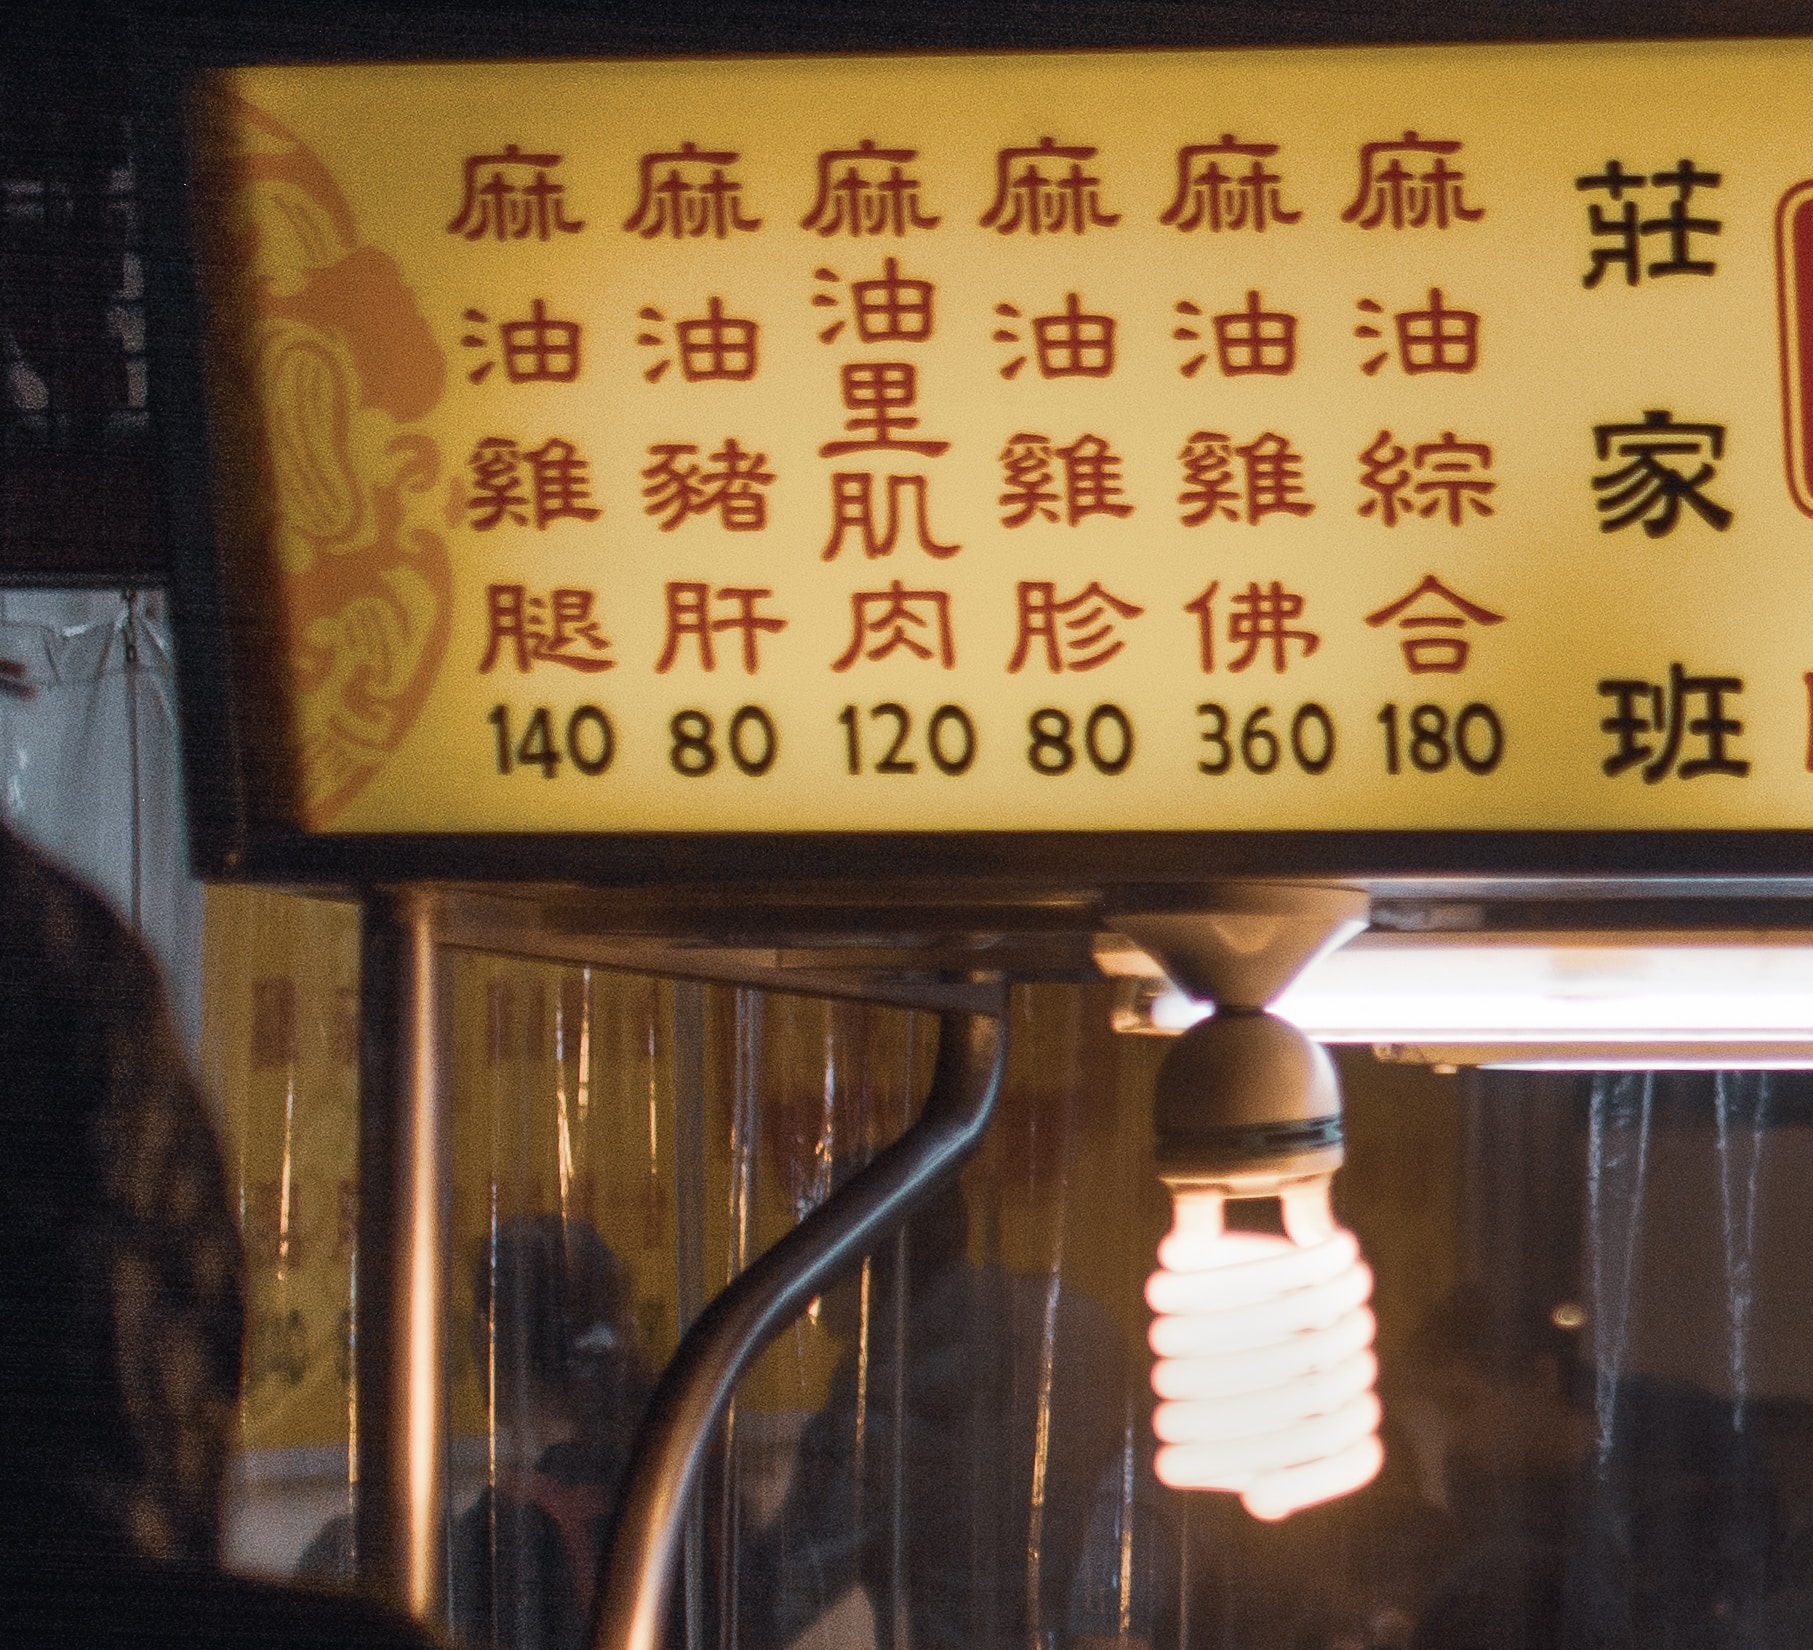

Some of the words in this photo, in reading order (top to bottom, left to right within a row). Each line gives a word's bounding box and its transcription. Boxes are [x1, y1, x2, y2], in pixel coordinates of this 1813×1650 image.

[447, 145, 612, 673] 麻油雞腿
[624, 142, 786, 673] 麻油豬肝
[801, 140, 960, 671] 麻油里肌肉
[980, 136, 1143, 672] 麻油雞胗
[1160, 134, 1320, 672] 麻油雞佛
[1342, 131, 1504, 674] 麻油綜合
[1576, 159, 1750, 783] 莊家班
[489, 704, 615, 778] 140
[670, 705, 777, 777] 80
[840, 702, 976, 776] 120
[1028, 703, 1134, 775] 80
[1198, 702, 1335, 775] 360
[1378, 702, 1504, 775] 180
